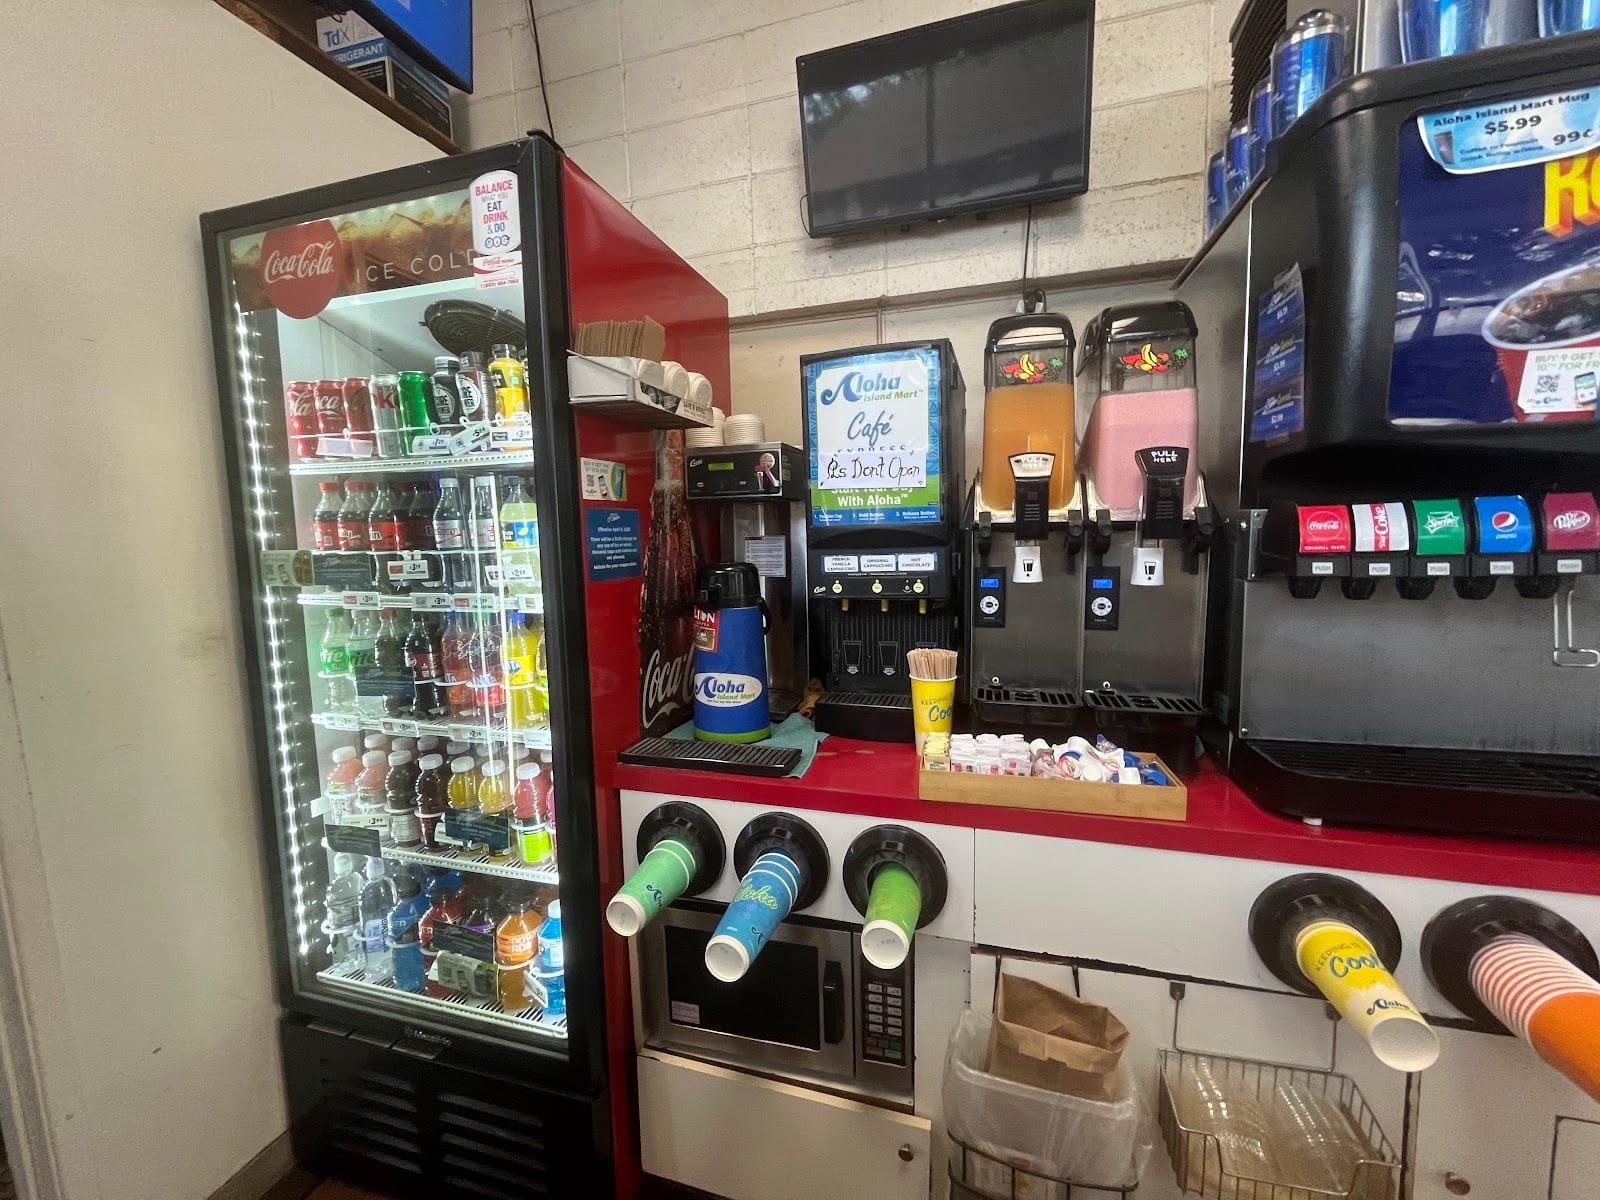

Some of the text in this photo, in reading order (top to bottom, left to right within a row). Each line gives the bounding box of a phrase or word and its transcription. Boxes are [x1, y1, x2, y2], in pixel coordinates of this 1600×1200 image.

[1433, 91, 1590, 127] Aloha Island Mart Mug
[1484, 115, 1542, 135] $5.99
[475, 180, 513, 196] BALANCE
[497, 191, 508, 200] YOU
[487, 200, 502, 212] EAT
[483, 211, 508, 224] DRINK
[487, 222, 505, 235] & DO
[356, 262, 395, 285] ICE
[864, 390, 892, 402] Island
[847, 410, 895, 447] Café
[1150, 449, 1178, 458] PULL
[1153, 456, 1178, 464] HERE
[837, 494, 864, 507] With
[1374, 506, 1389, 535] Coke
[1315, 942, 1352, 972] KEEPING
